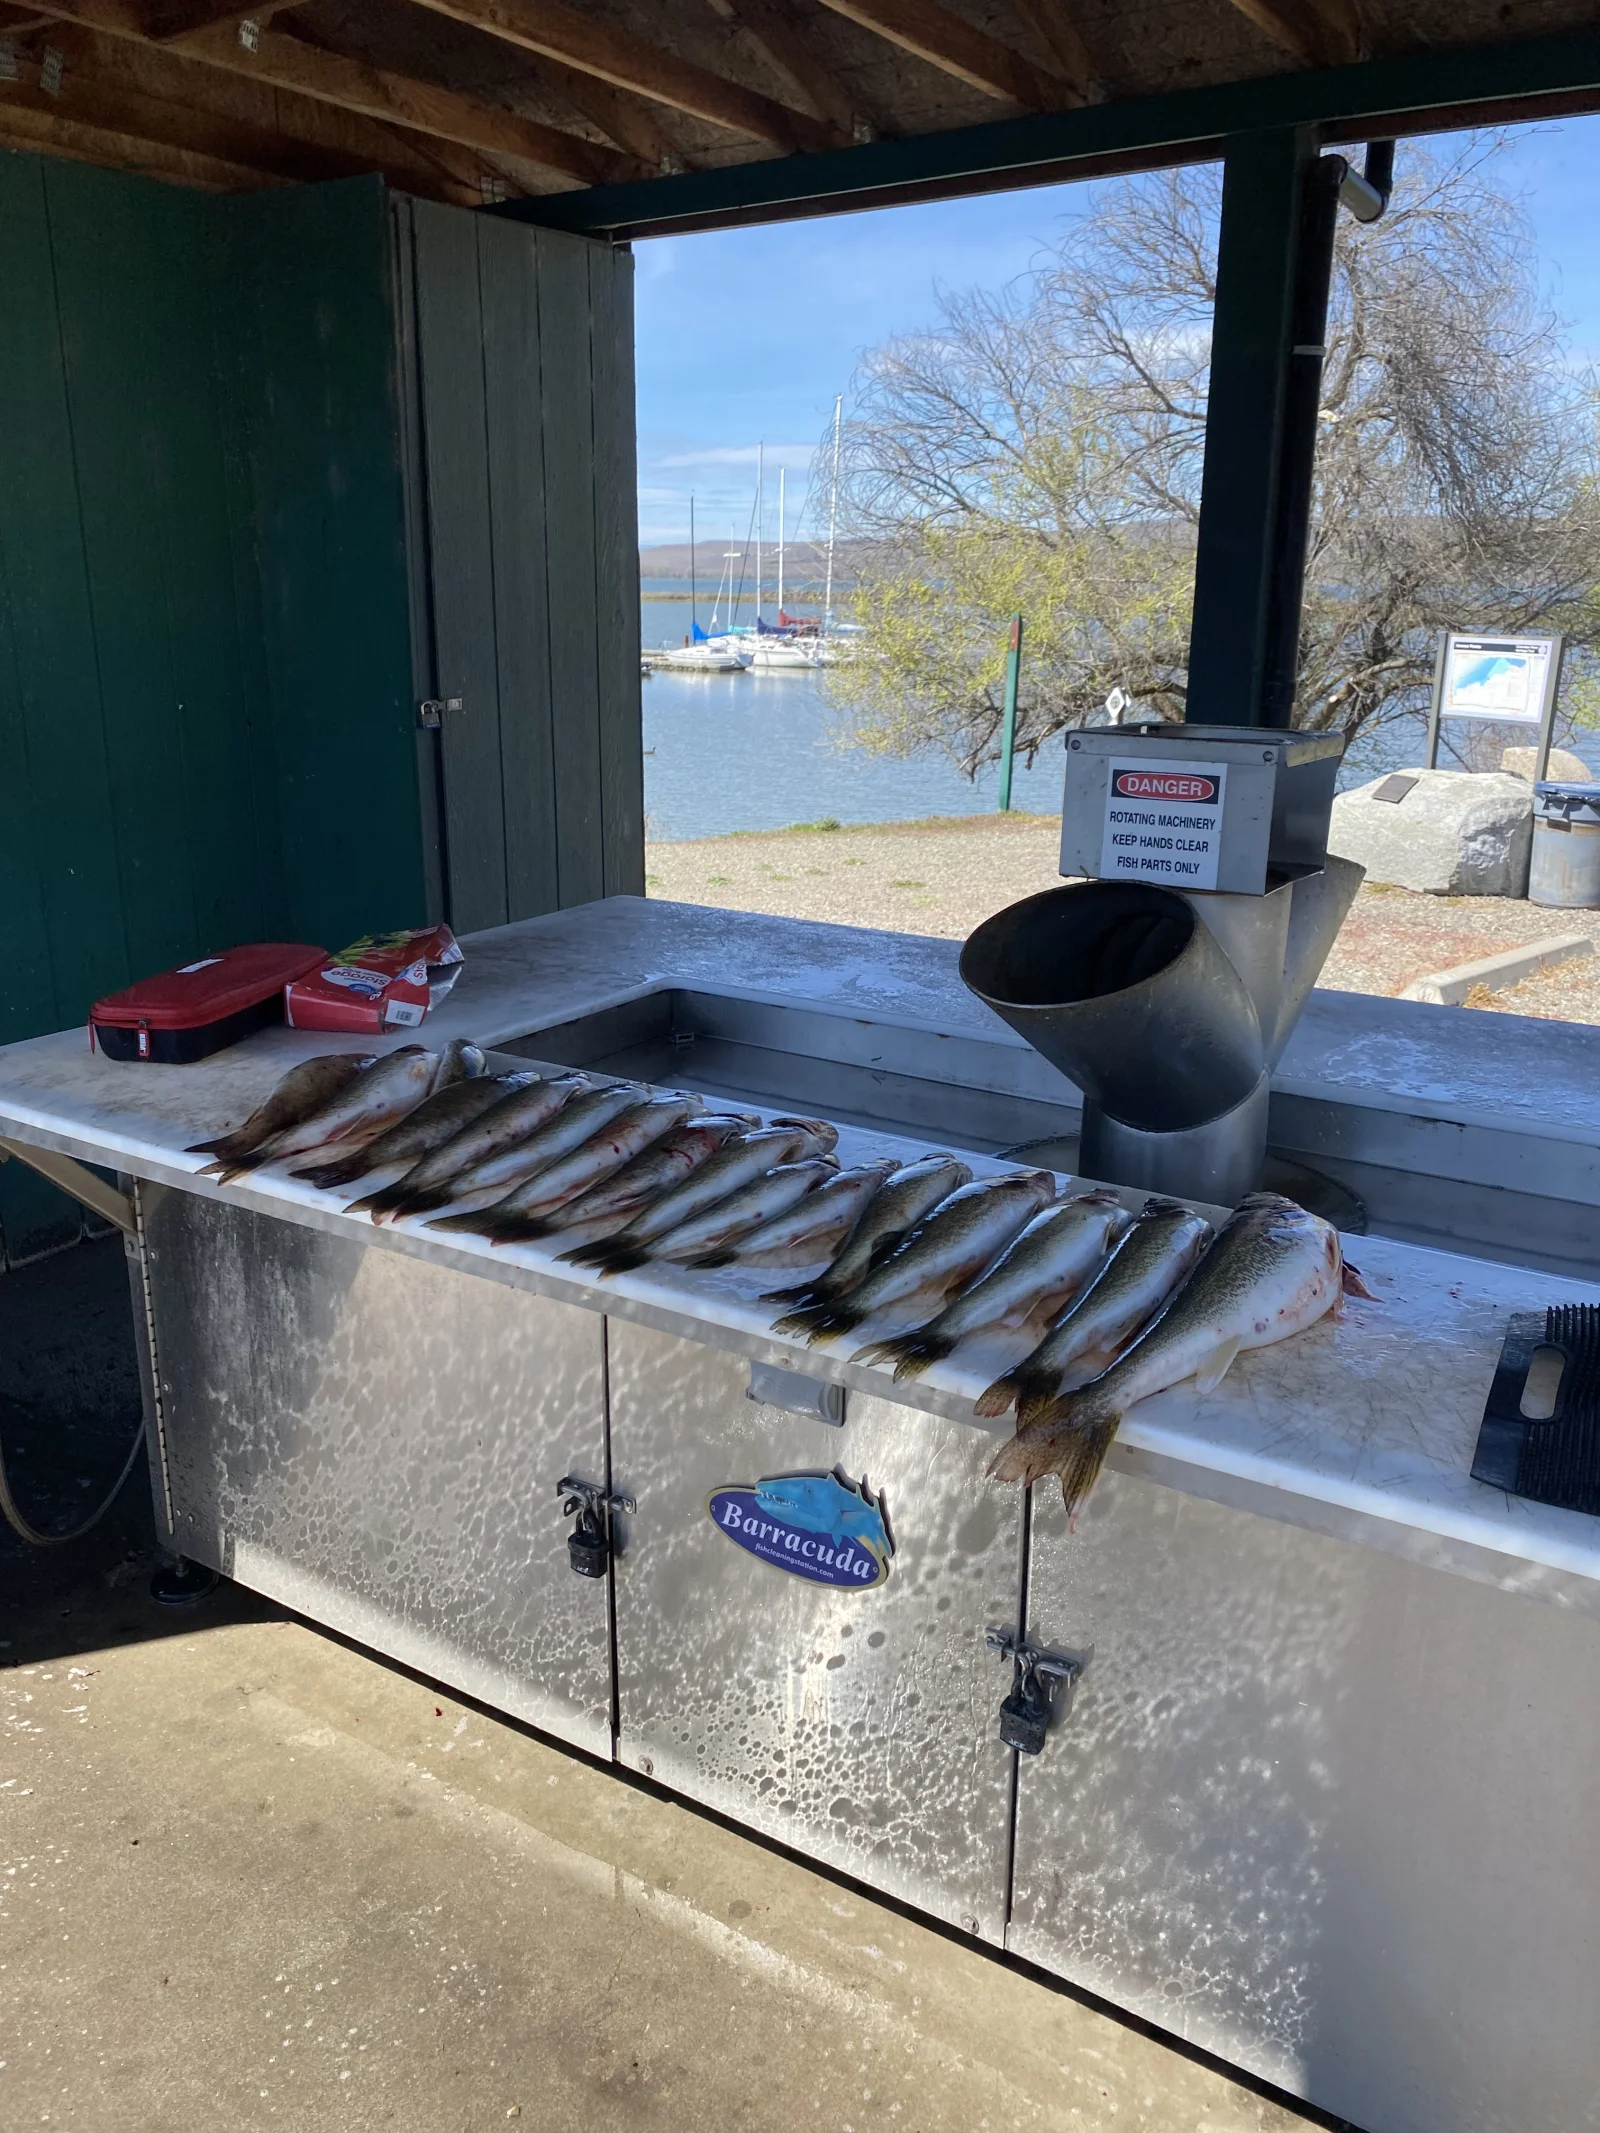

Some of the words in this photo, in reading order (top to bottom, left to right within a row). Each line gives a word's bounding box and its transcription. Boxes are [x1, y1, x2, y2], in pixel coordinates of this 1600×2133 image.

[1127, 777, 1203, 797] DANGER
[1109, 811, 1156, 826] ROTATING
[1158, 815, 1216, 831] MACHINERY
[1112, 833, 1138, 847] KEEP
[1139, 836, 1174, 850] HANDS
[1175, 838, 1209, 853] CLEAR
[1117, 856, 1139, 869] FISH
[1140, 858, 1172, 872] PARTS
[1174, 861, 1200, 875] ONLY
[331, 970, 388, 986] Storage
[721, 1501, 870, 1579] Barracuda
[755, 1542, 834, 1579] fishcleaningstation.com
